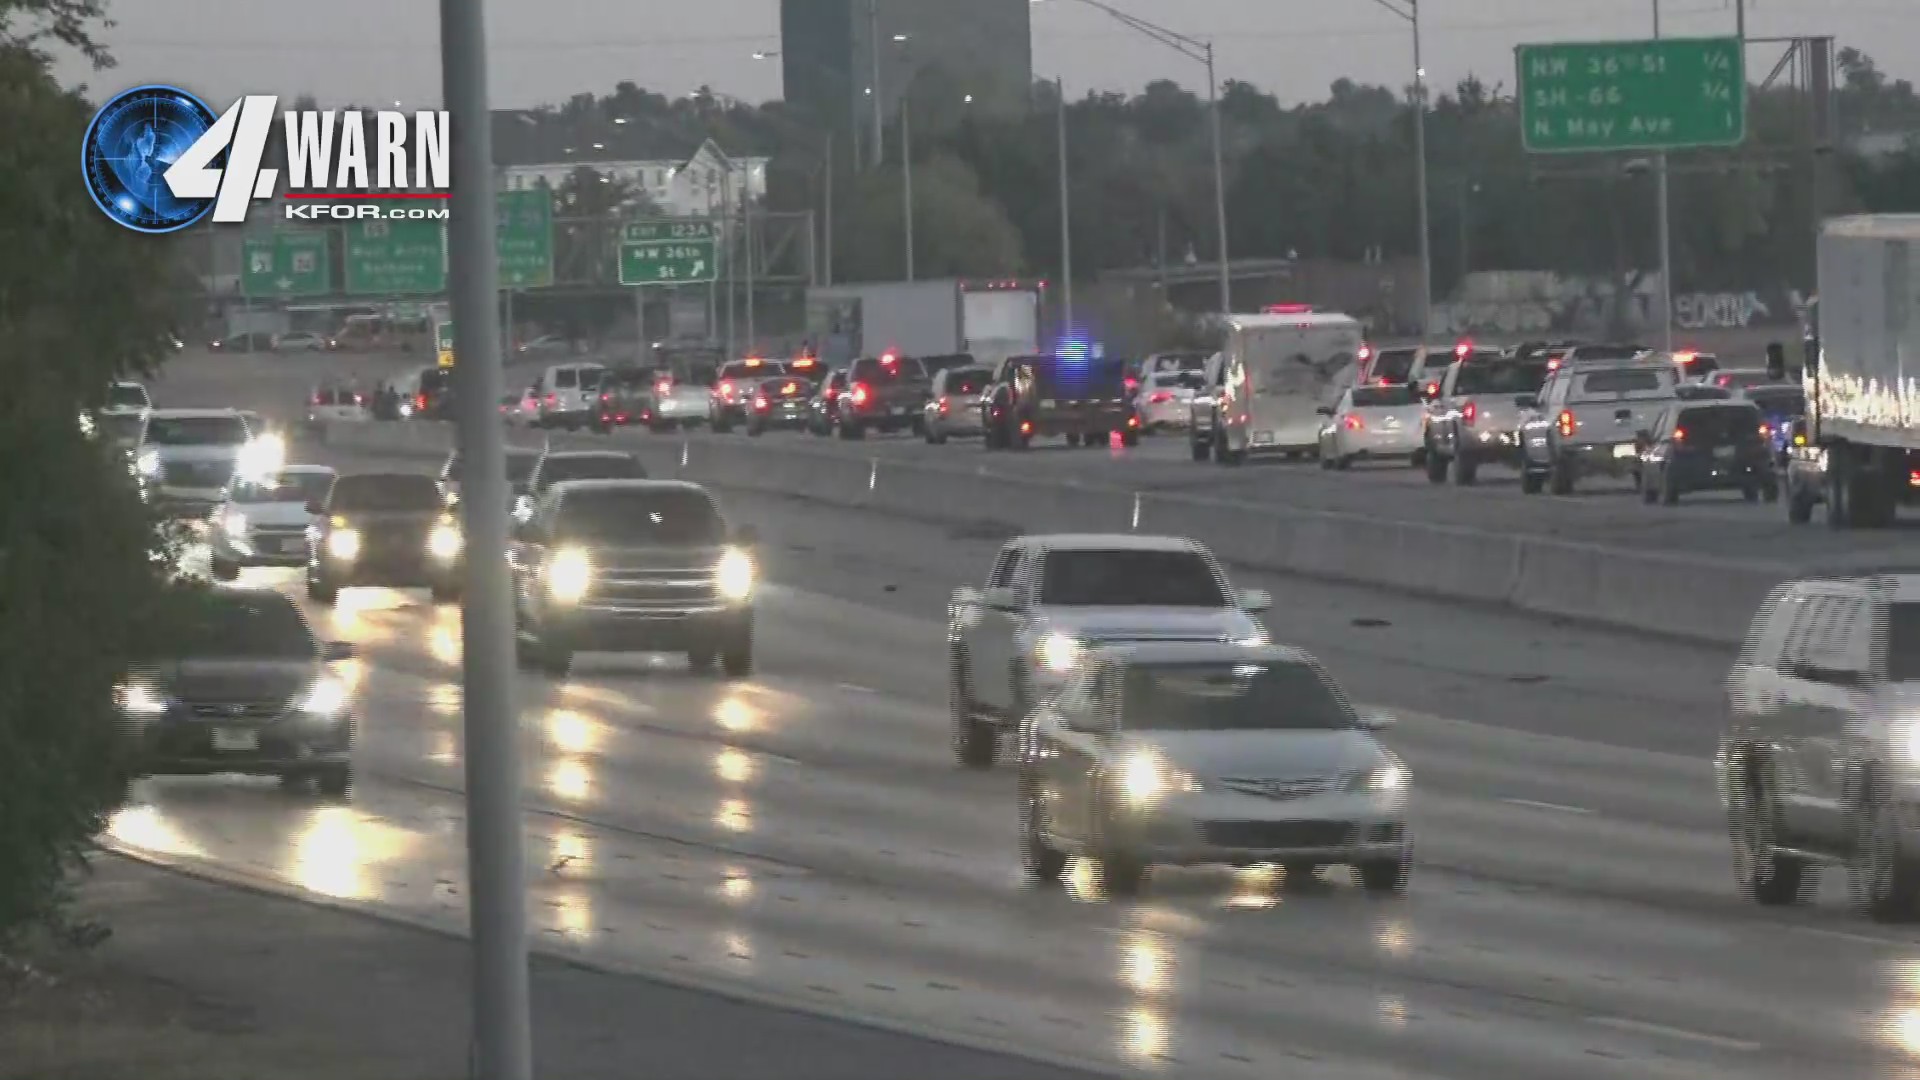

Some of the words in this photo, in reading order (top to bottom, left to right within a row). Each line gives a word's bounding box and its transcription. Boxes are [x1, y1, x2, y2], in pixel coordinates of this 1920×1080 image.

[1532, 56, 1568, 77] NW
[1703, 50, 1729, 70] 1/4
[1567, 117, 1615, 137] May
[1628, 115, 1672, 134] Ave
[672, 223, 709, 237] 123A
[634, 247, 659, 259] NW
[659, 265, 676, 278] St
